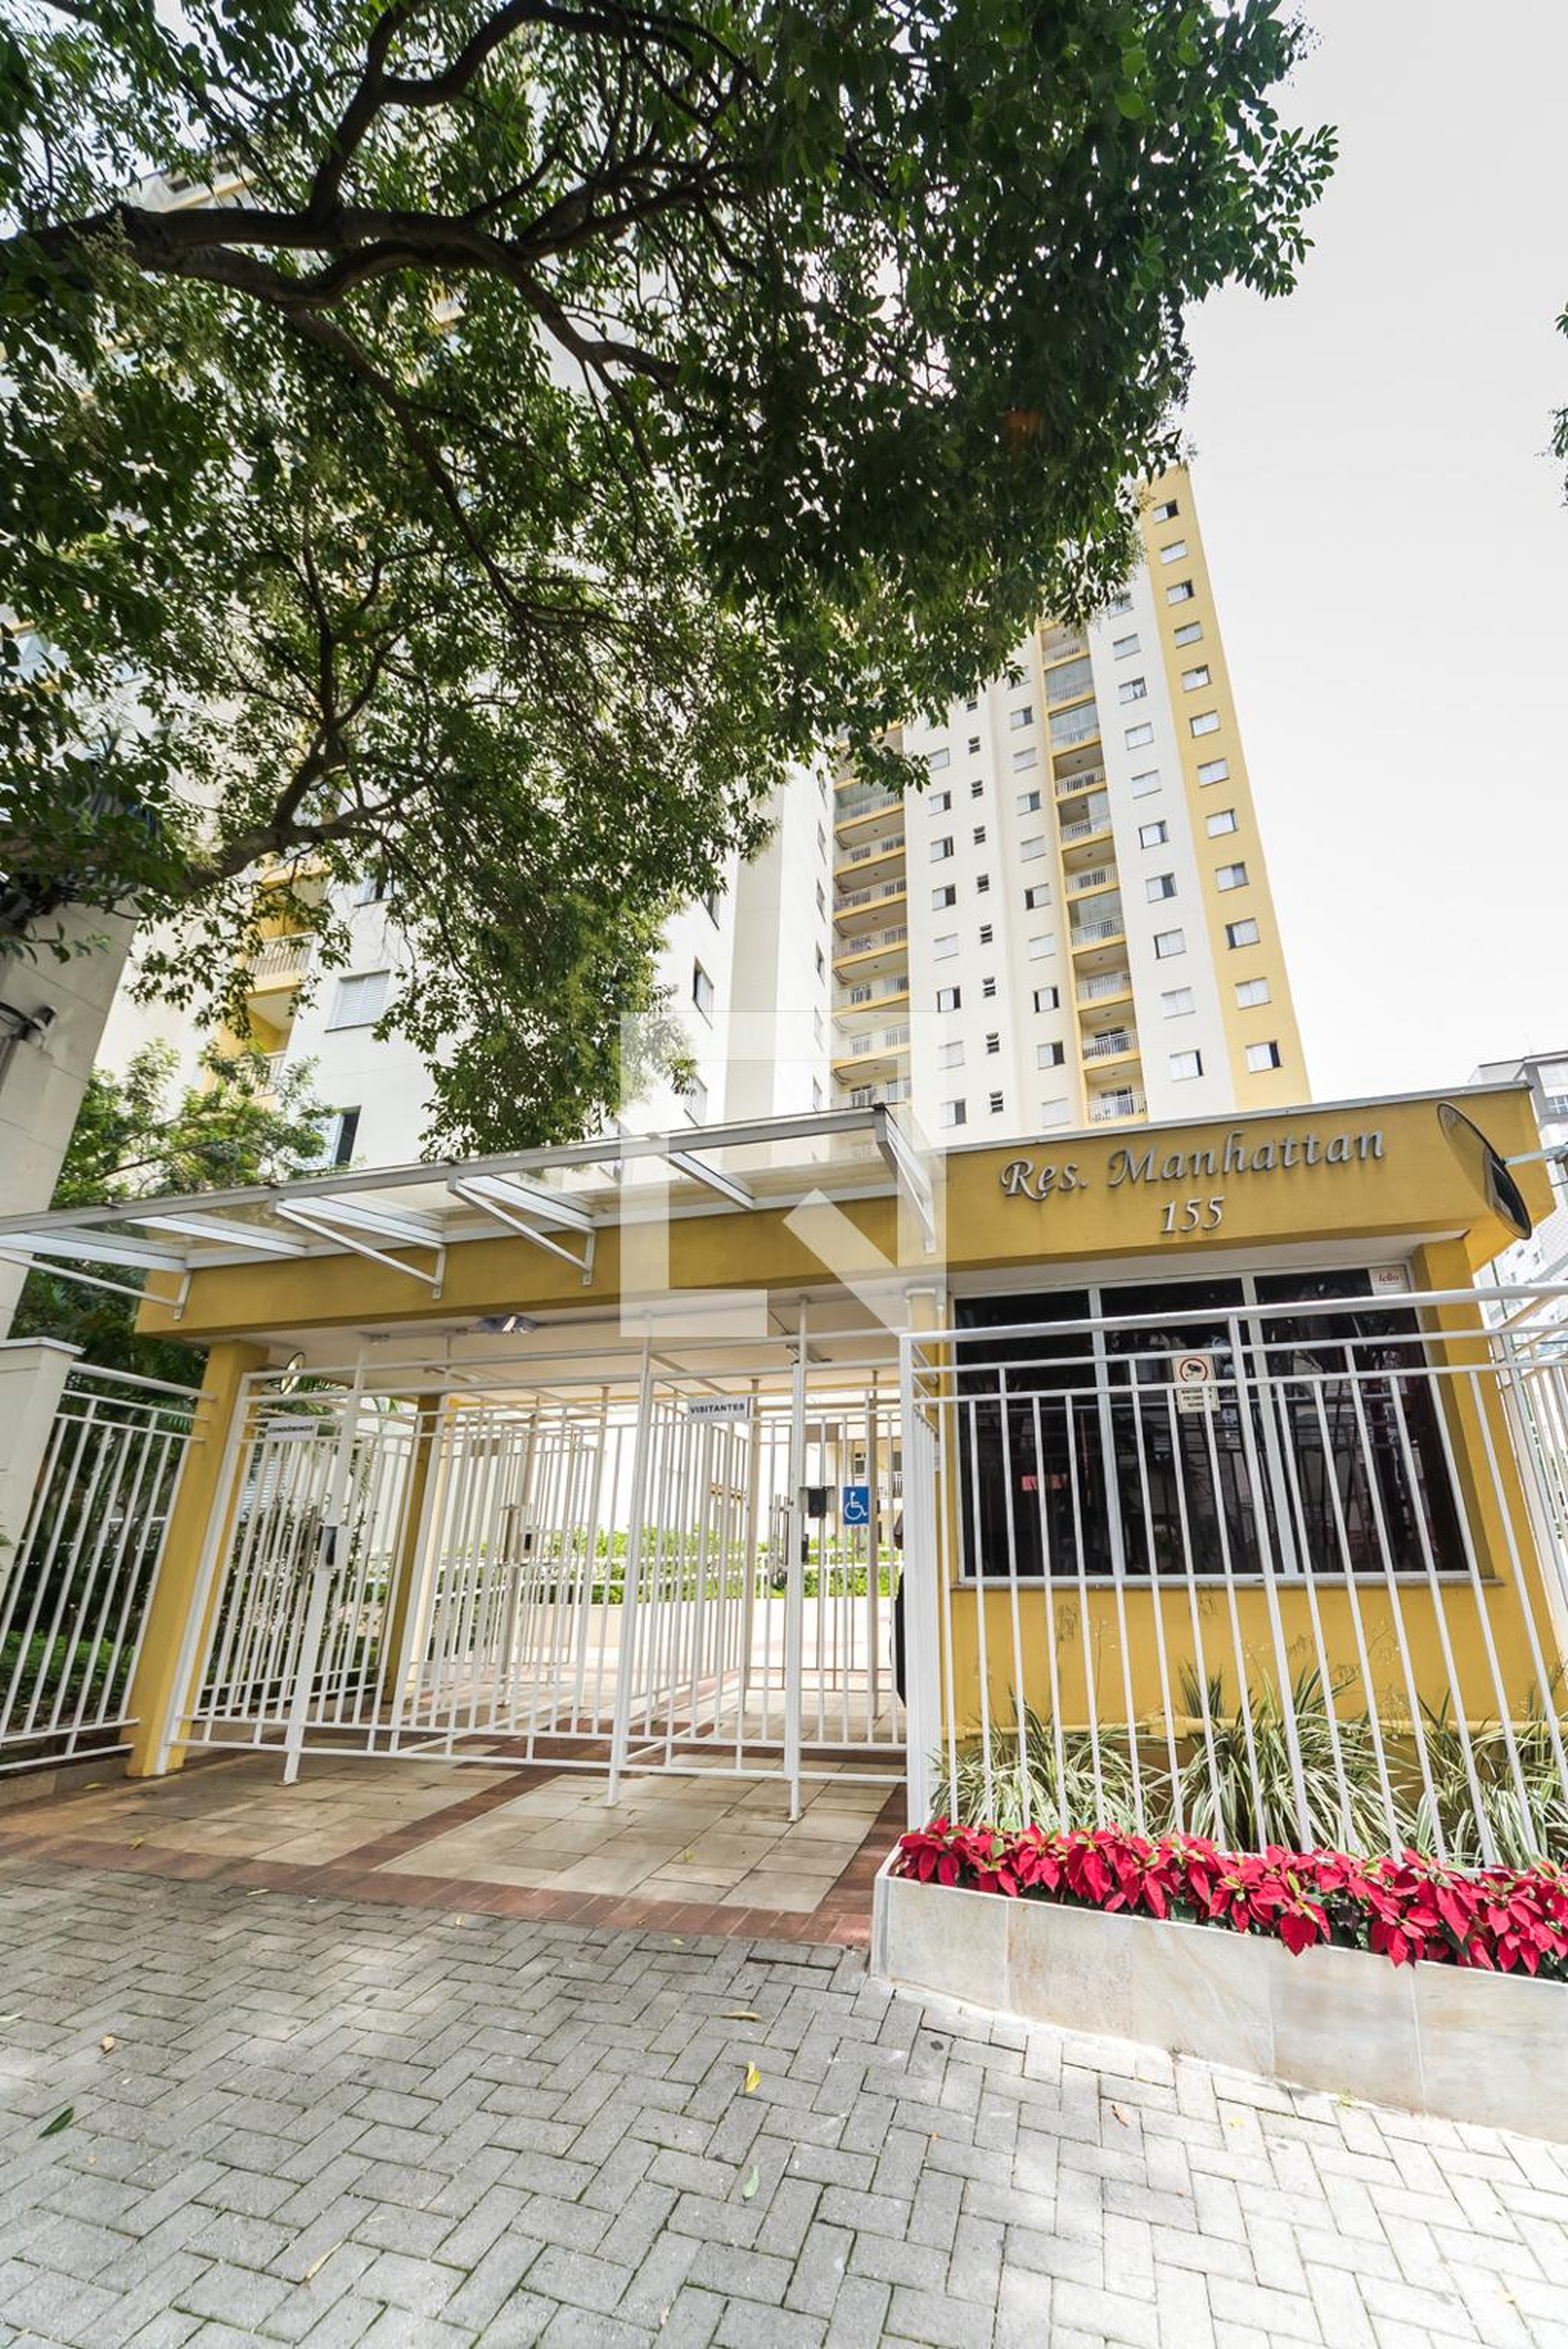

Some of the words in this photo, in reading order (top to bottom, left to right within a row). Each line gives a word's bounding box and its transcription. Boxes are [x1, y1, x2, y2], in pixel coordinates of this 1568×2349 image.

[1000, 1156, 1089, 1201] Res.
[1108, 1129, 1385, 1187] Manhattan
[1161, 1195, 1225, 1234] 155
[690, 1403, 744, 1414] VISITANTES
